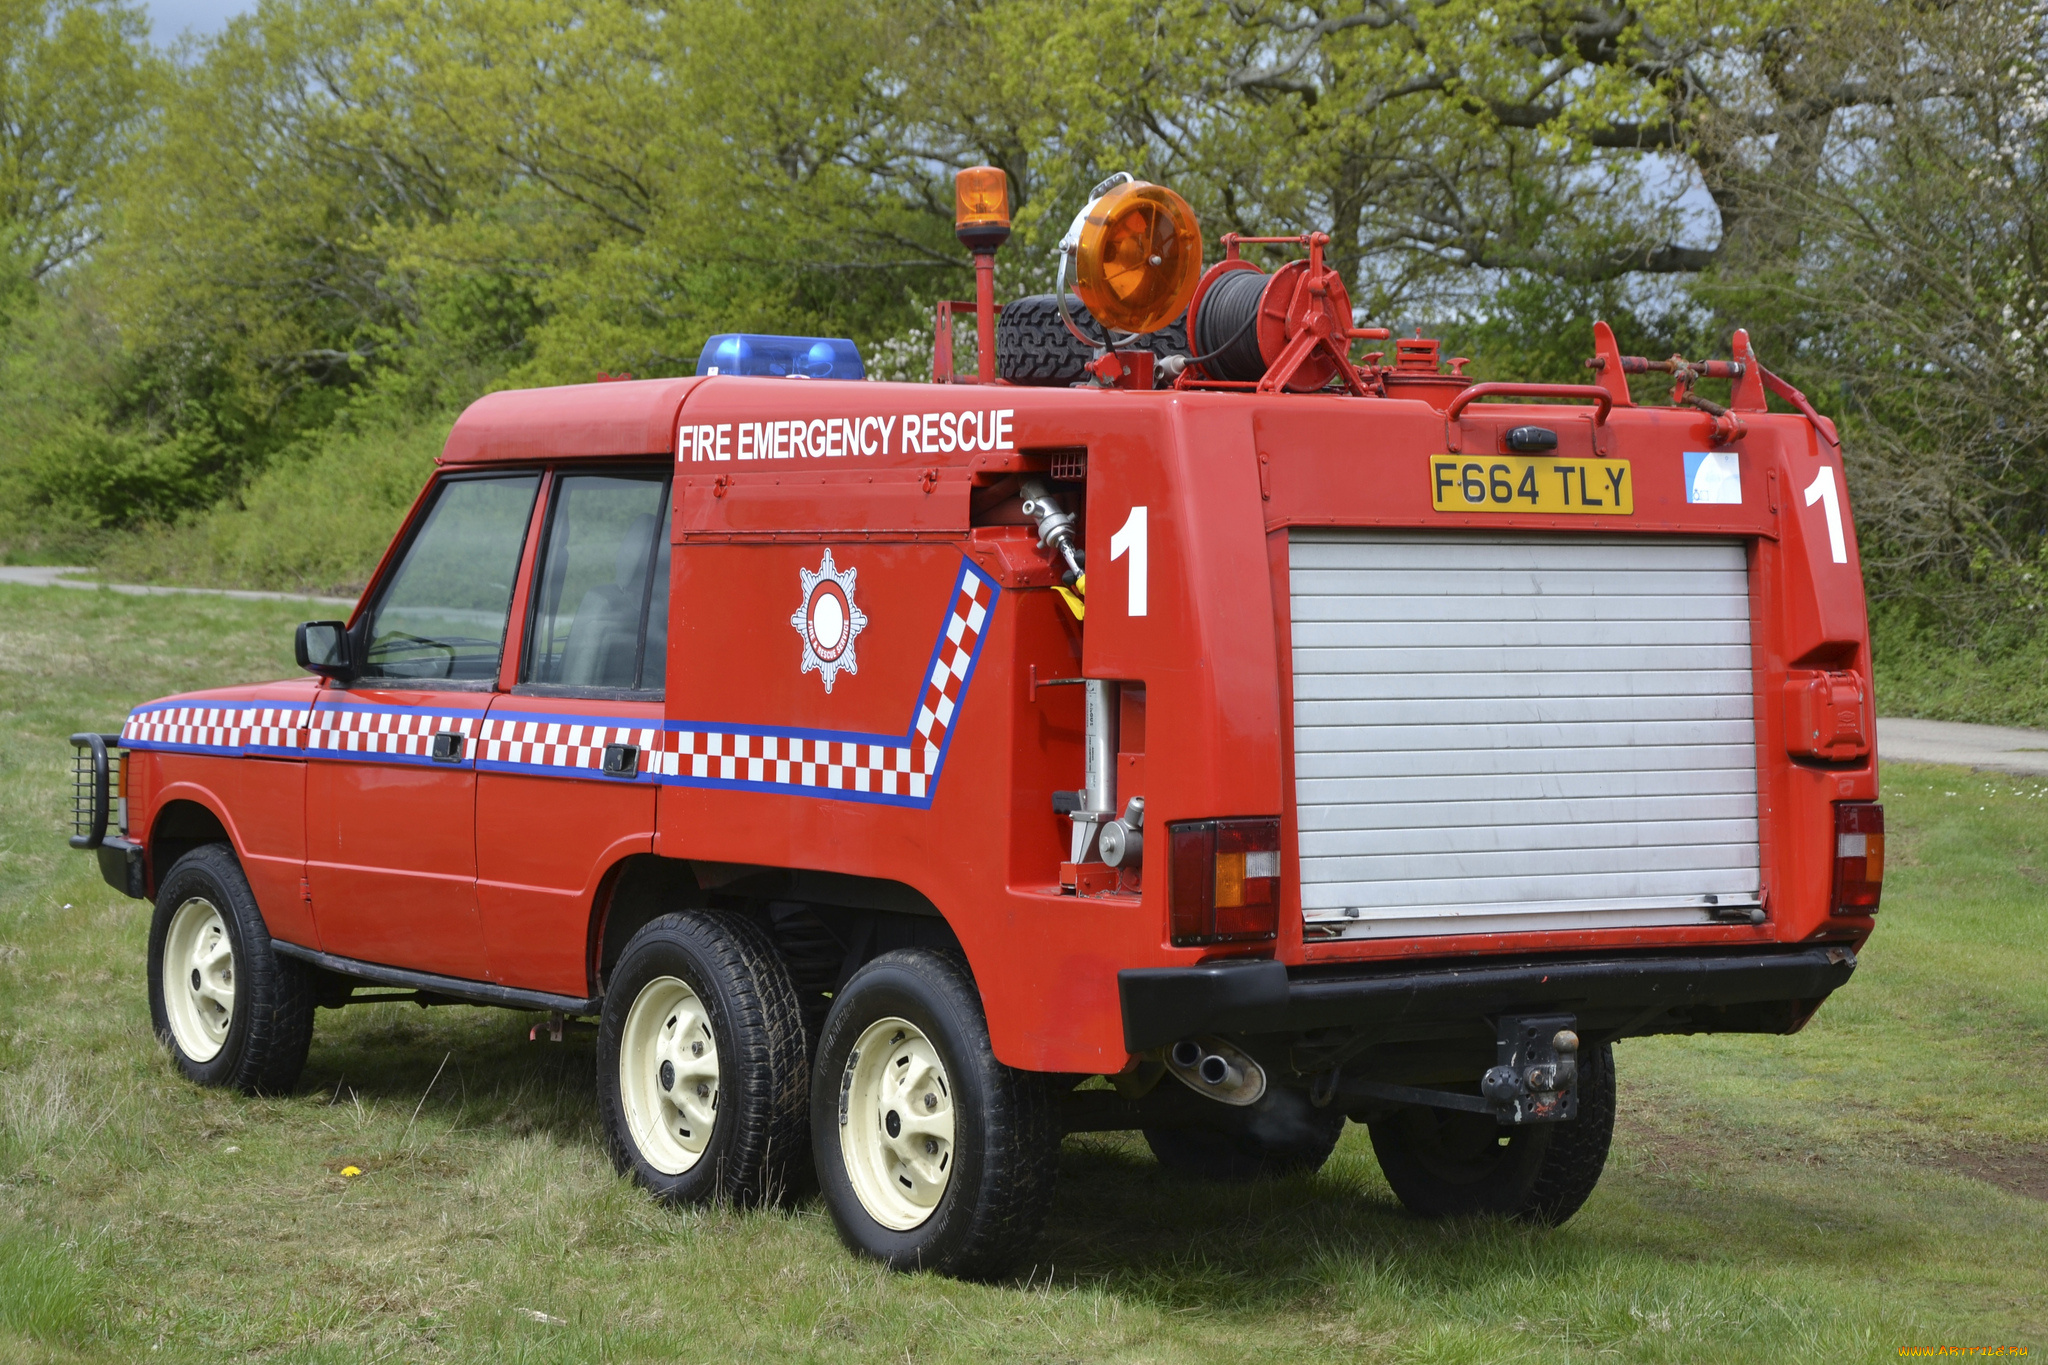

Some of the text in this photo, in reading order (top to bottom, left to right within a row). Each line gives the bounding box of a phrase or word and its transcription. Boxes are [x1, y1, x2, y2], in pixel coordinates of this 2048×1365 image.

[678, 409, 1014, 462] FIRE EMERGENCY RESCUE
[1435, 462, 1625, 507] F664 TLY
[1804, 466, 1848, 564] 1
[1110, 506, 1148, 617] 1
[836, 620, 849, 653] SERVICE
